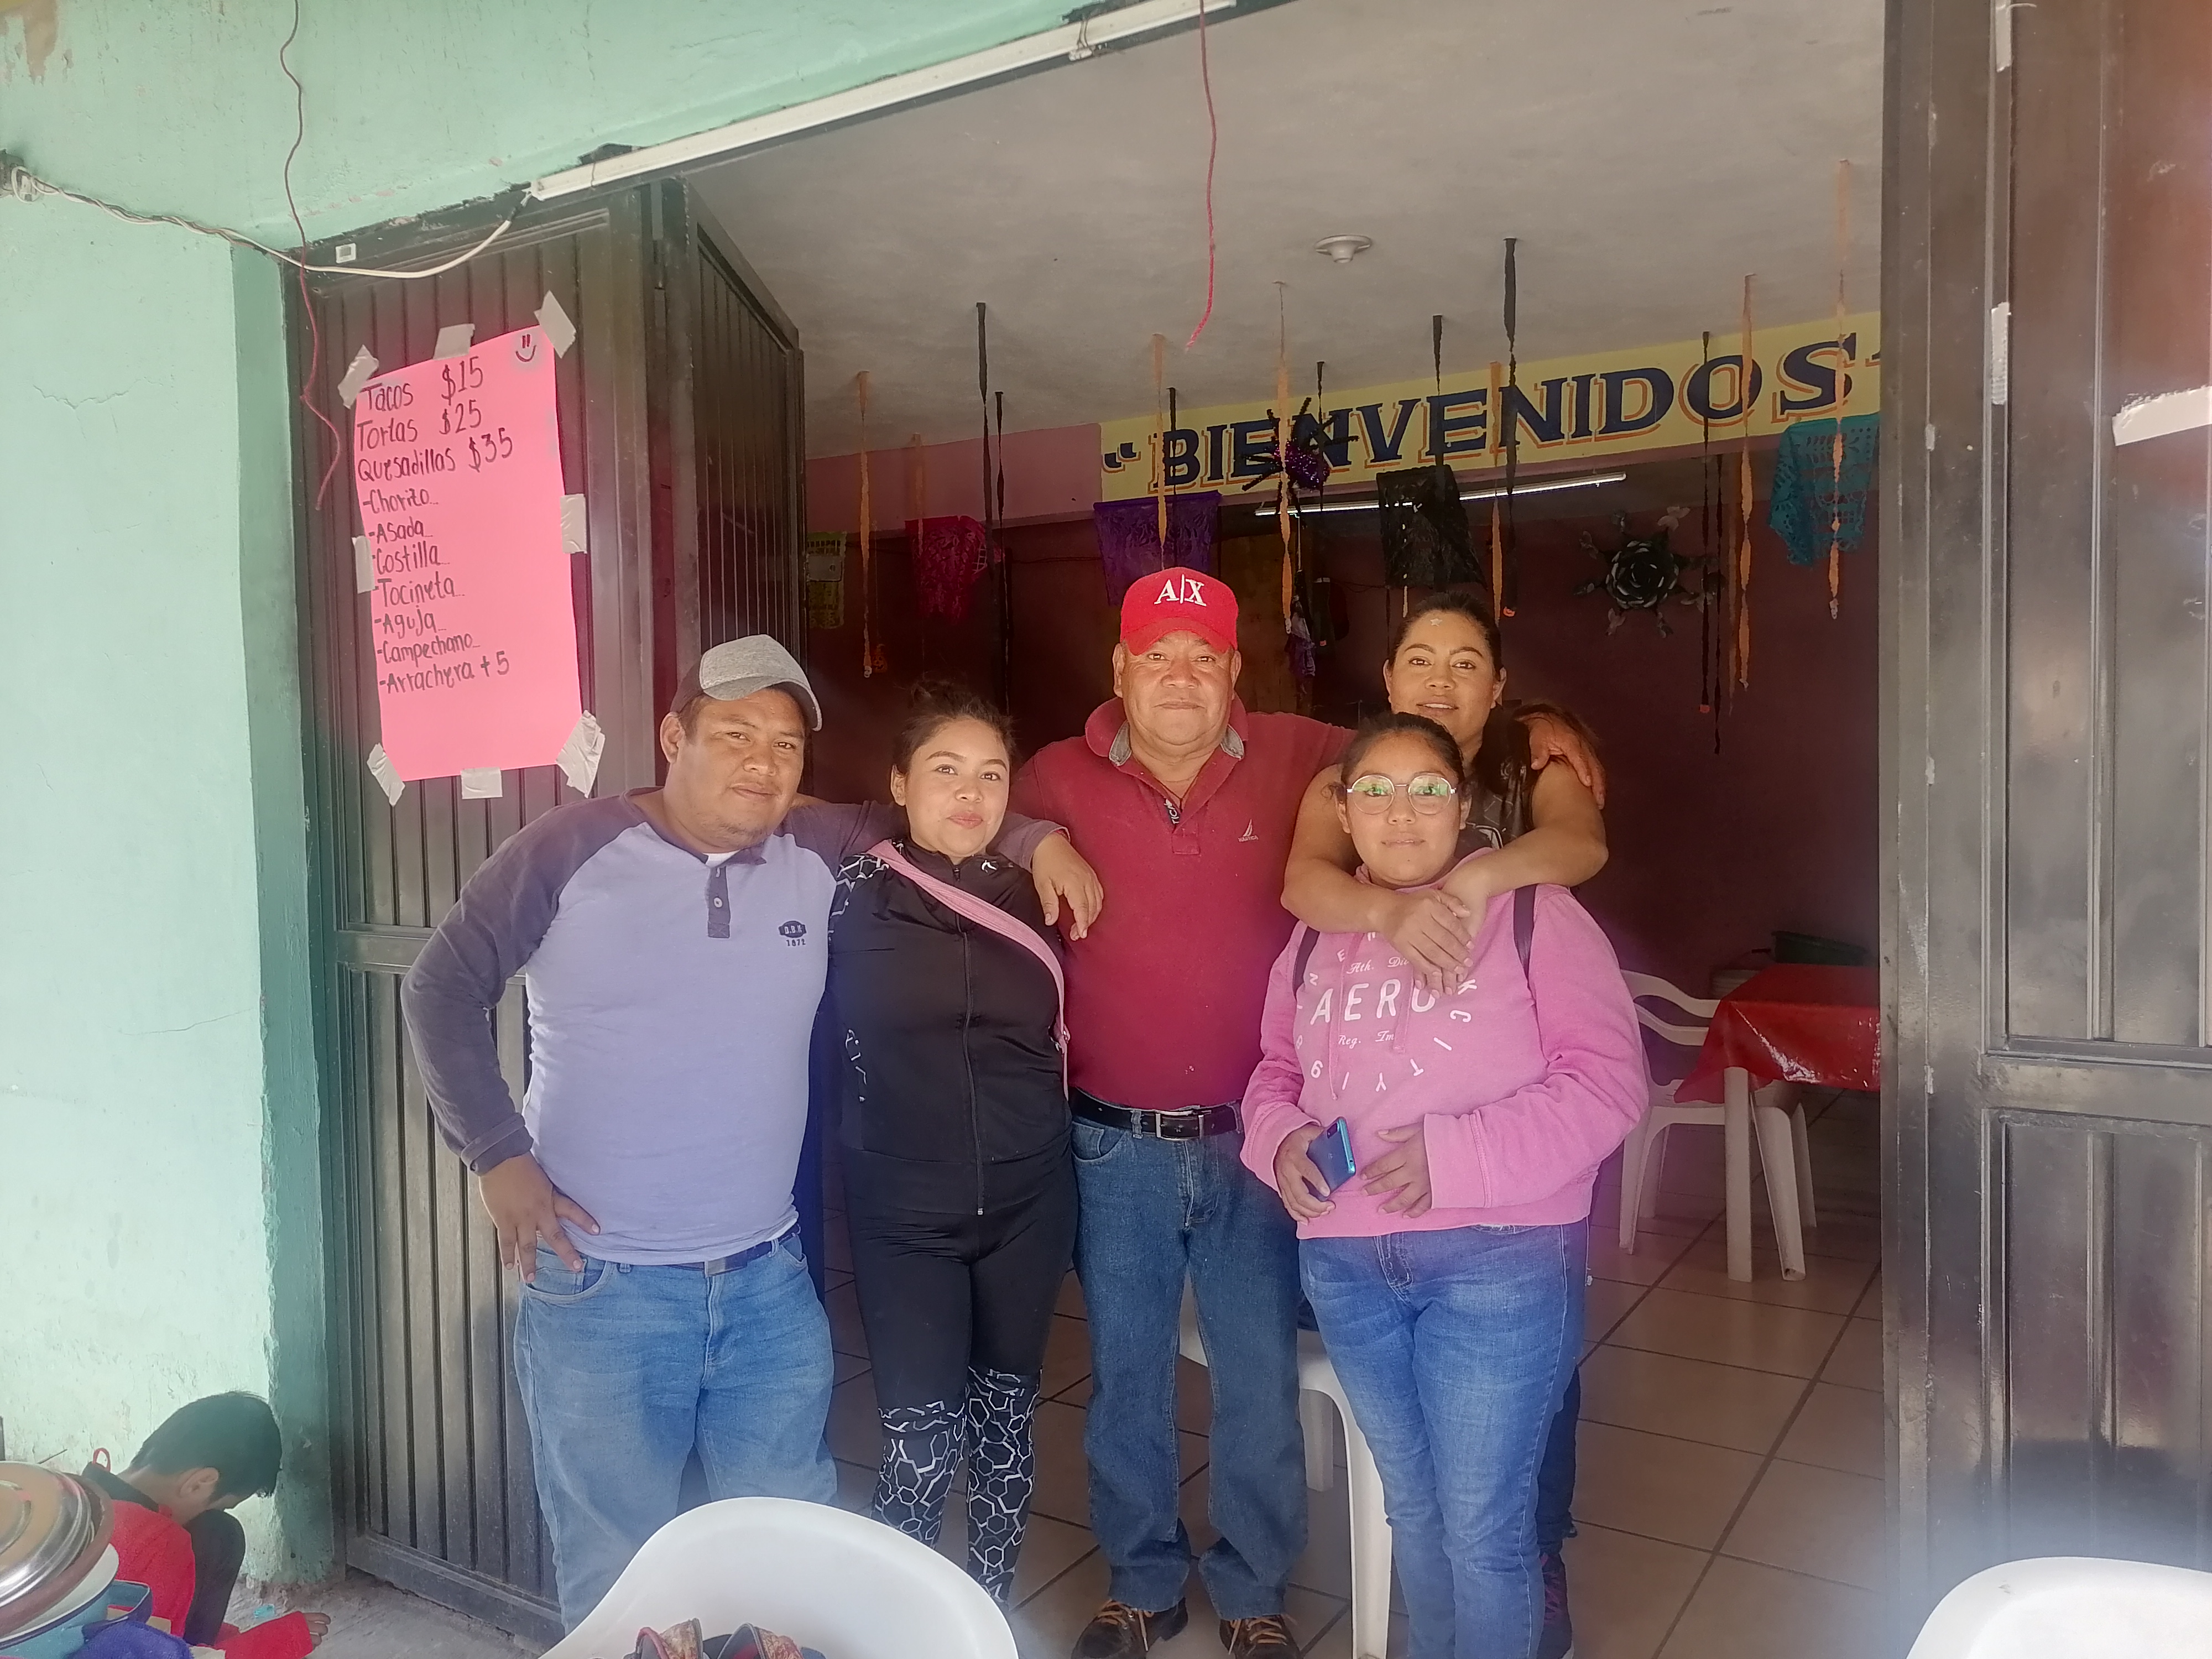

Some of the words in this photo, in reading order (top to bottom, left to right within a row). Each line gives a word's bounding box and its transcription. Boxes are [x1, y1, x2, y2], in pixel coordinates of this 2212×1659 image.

[359, 383, 414, 411] Tacos
[441, 356, 483, 406] $15
[357, 417, 418, 451] Tortas
[439, 399, 482, 435] $25
[358, 447, 456, 482] Quesadillas
[468, 427, 513, 473] $35
